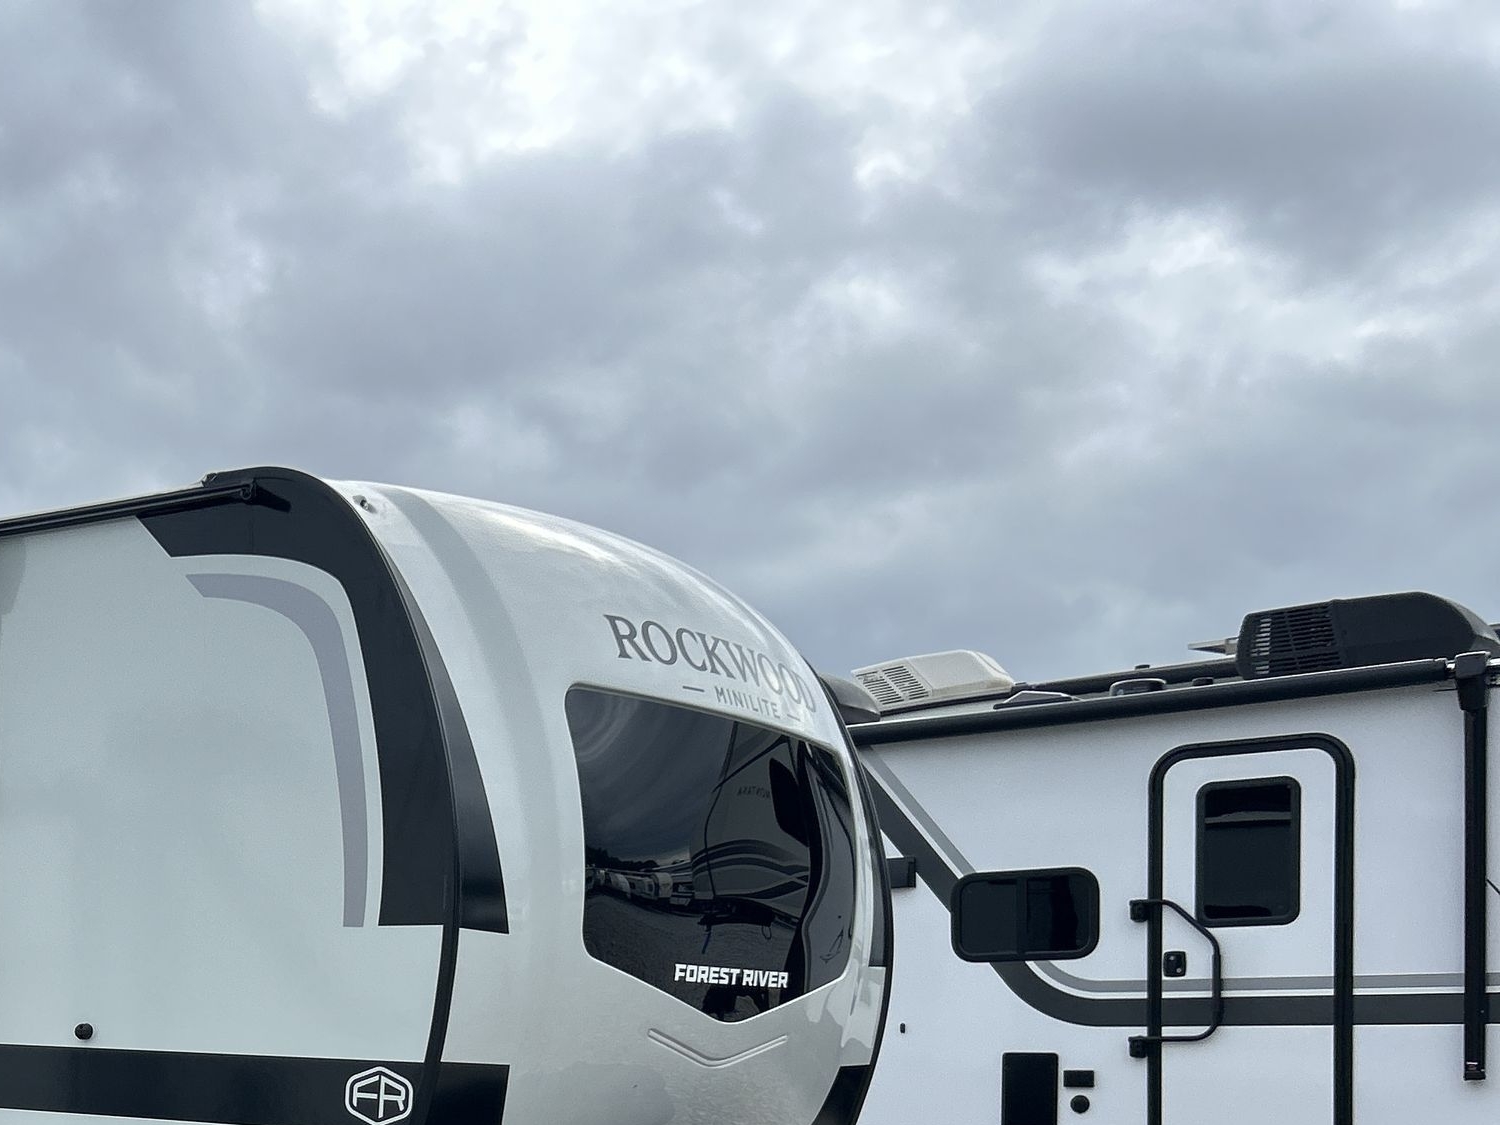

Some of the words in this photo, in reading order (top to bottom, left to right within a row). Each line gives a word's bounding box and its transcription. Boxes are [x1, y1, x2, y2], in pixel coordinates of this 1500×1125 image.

[602, 614, 817, 713] ROCKWOOD
[714, 685, 781, 720] MINILITE
[674, 963, 741, 986] FOREST
[742, 968, 789, 989] RIVER
